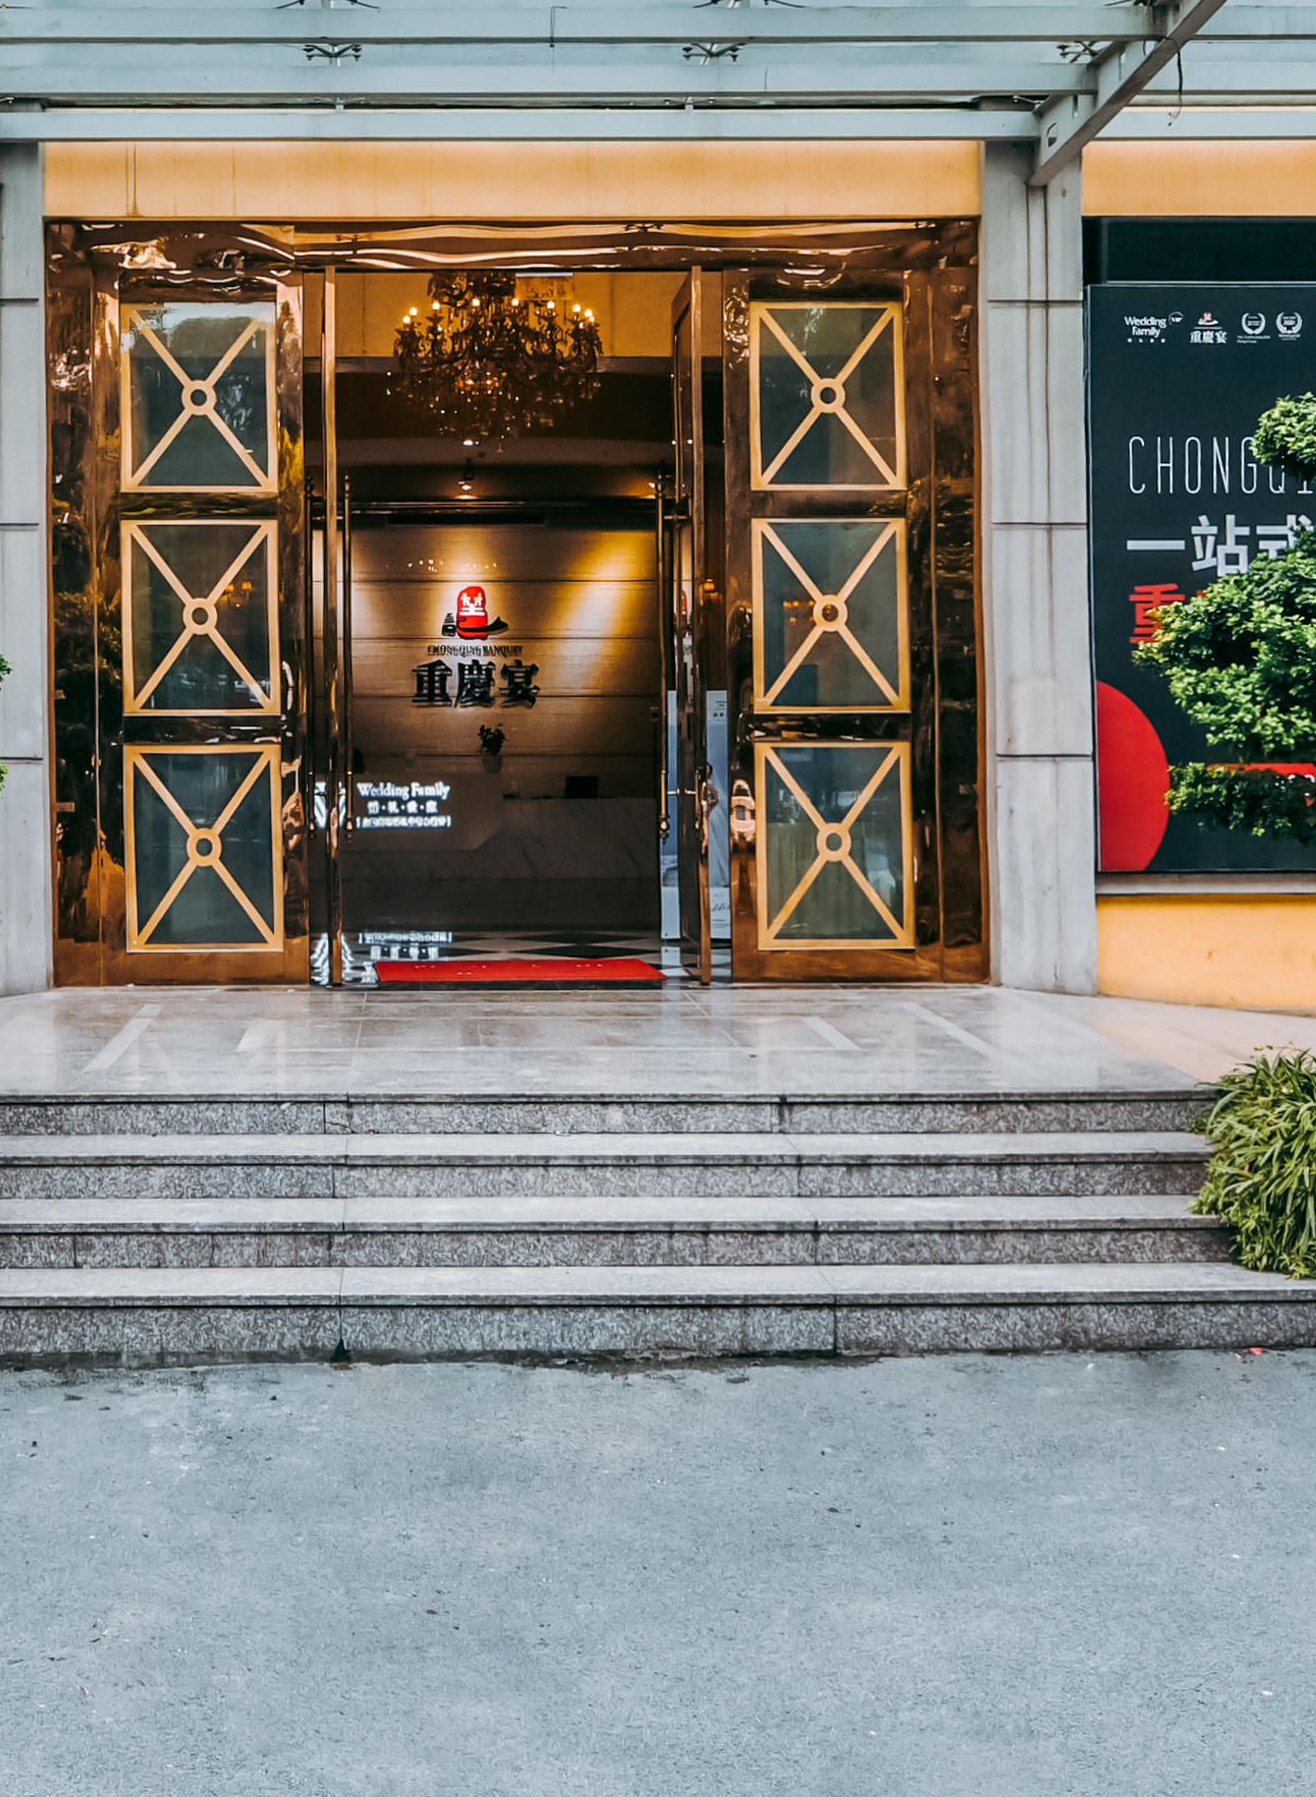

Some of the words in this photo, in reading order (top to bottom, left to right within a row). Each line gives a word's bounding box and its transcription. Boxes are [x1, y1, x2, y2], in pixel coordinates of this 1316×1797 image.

[1124, 316, 1167, 329] Wedding
[1132, 326, 1161, 338] Family
[1128, 435, 1314, 495] CHONGQ
[356, 781, 410, 801] Wedding
[410, 781, 451, 801] Family
